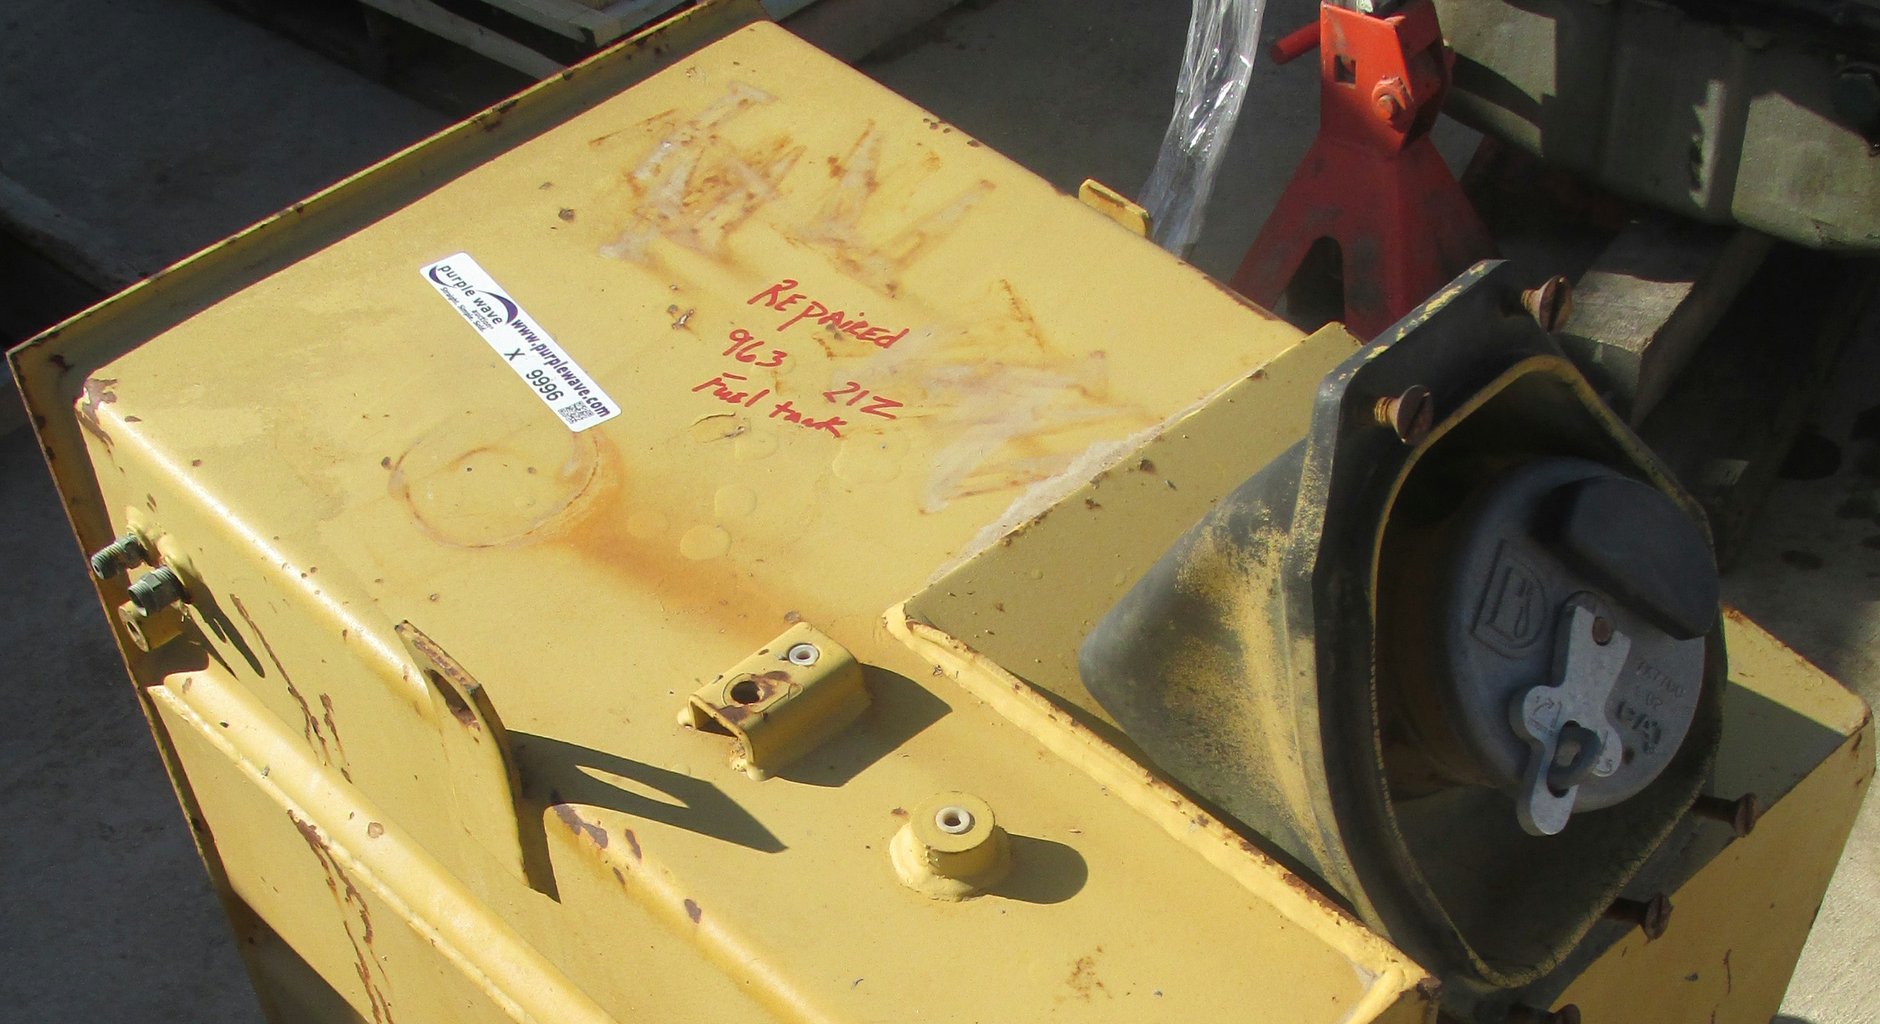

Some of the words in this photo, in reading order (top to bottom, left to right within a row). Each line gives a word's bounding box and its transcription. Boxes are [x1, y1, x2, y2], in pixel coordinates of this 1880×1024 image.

[437, 264, 476, 298] purple
[472, 297, 503, 325] wave
[503, 347, 526, 362] X
[525, 368, 565, 402] 9996
[510, 318, 612, 419] www.purplewave.com
[721, 328, 788, 368] 963
[691, 371, 770, 408] Fuel
